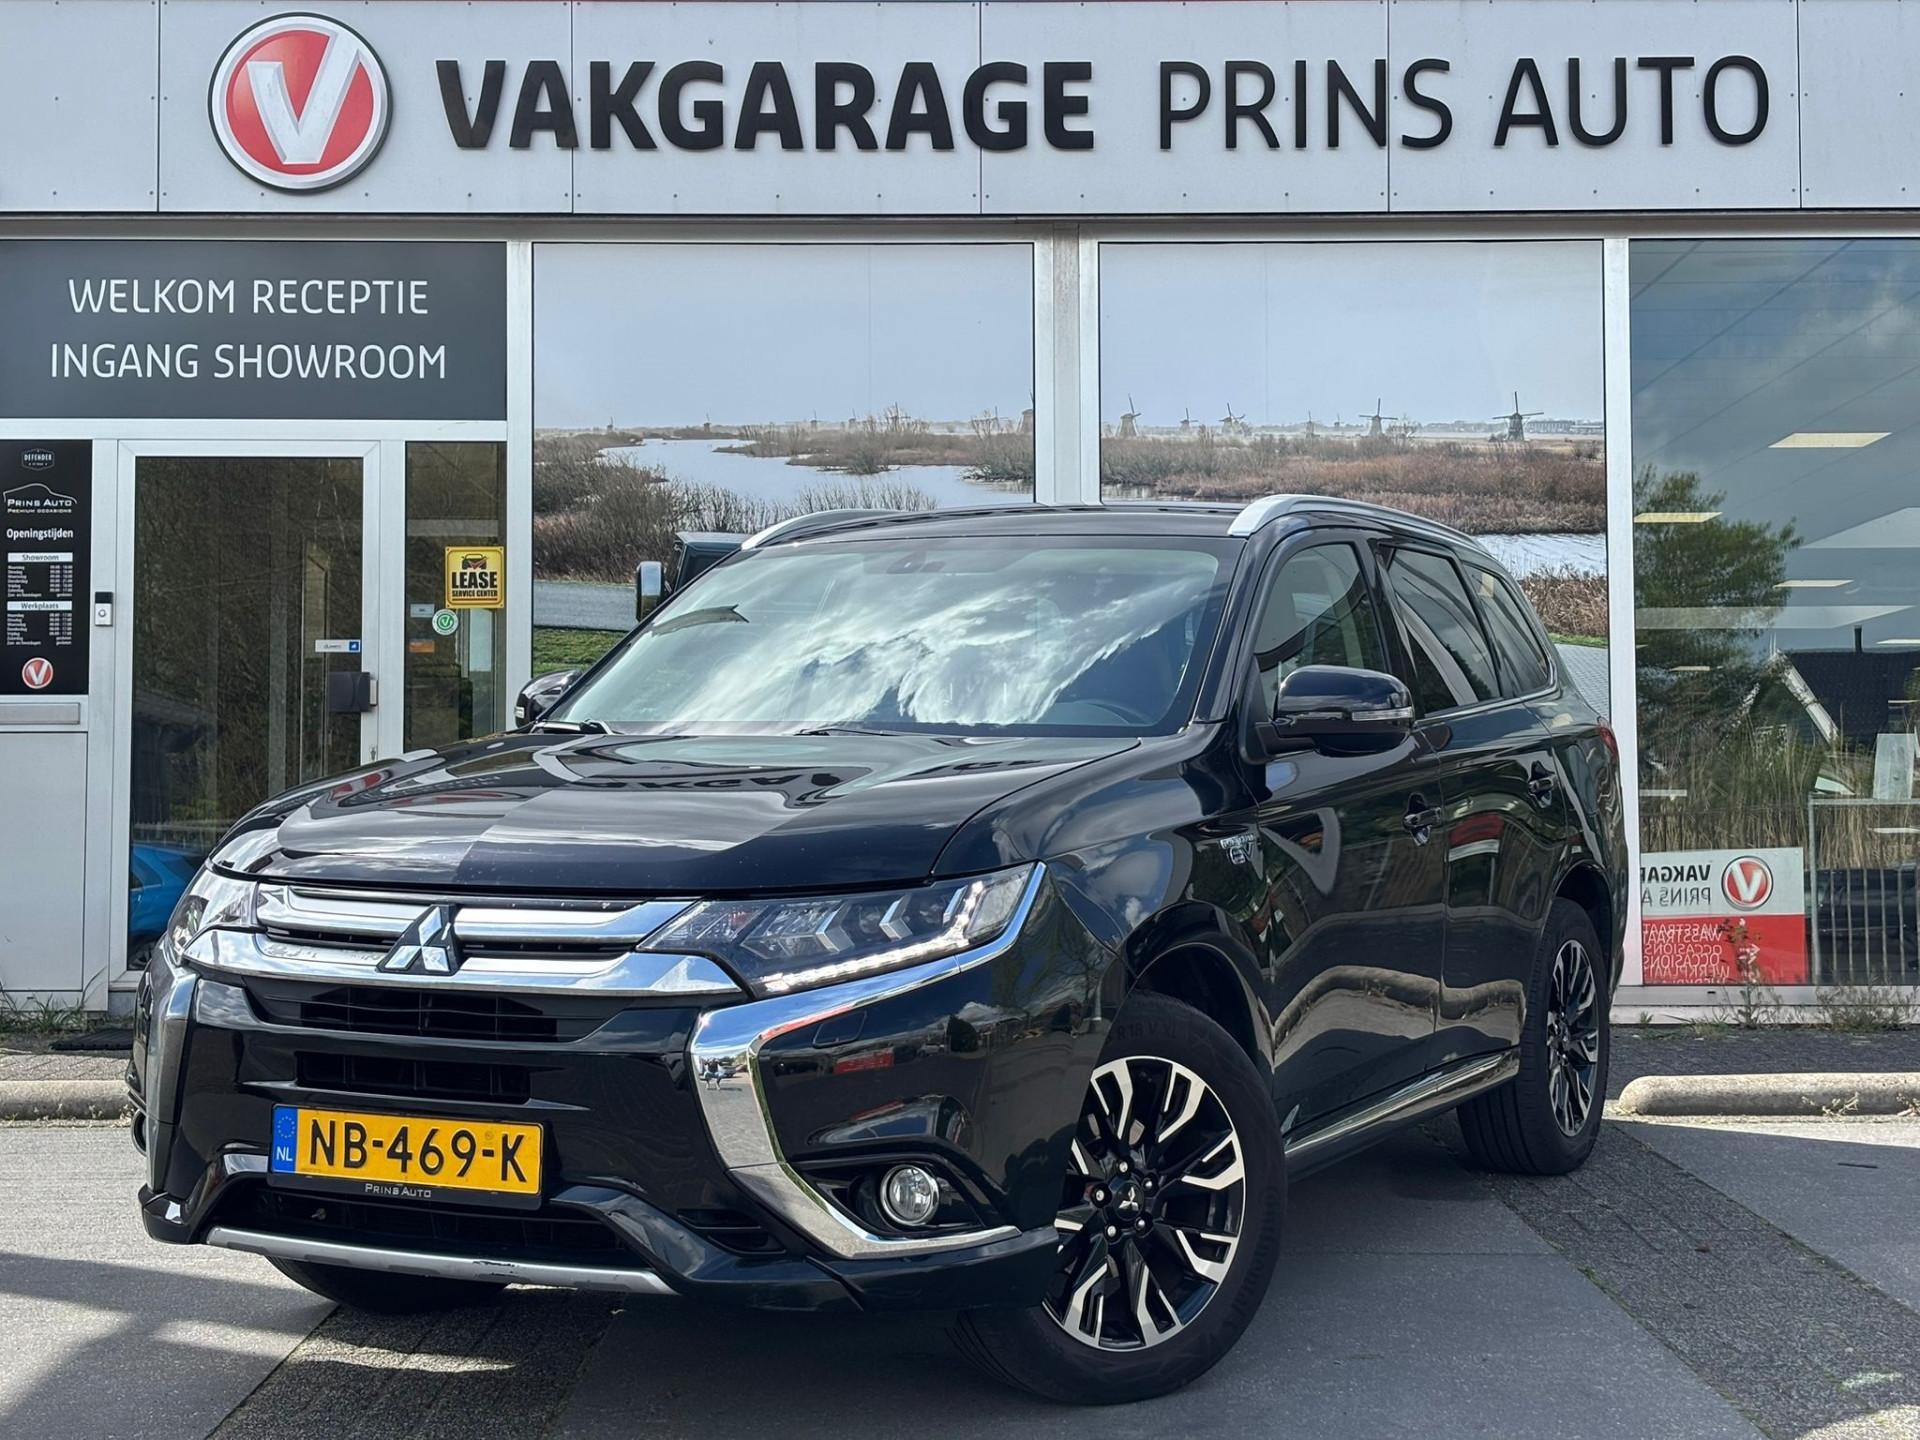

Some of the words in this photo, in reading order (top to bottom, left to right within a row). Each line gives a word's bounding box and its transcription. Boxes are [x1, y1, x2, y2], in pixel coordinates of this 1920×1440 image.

[436, 59, 1094, 151] VAKGARAGE
[1158, 58, 1453, 150] PRINS
[1492, 54, 1770, 147] AUTO
[68, 278, 236, 315] WELKOM
[252, 278, 429, 315] RECEPTIE
[50, 343, 200, 380] INGANG
[213, 343, 448, 380] SHOWROOM
[7, 498, 40, 507] PRINS
[43, 498, 73, 507] AUTO
[6, 527, 74, 541] Openingstijden
[22, 554, 59, 562] Showroom
[451, 571, 498, 589] LEASE
[451, 589, 476, 598] SERVICE
[476, 589, 498, 598] CENTER
[21, 602, 59, 611] Werkplaats
[276, 1145, 294, 1162] NL
[310, 1118, 528, 1184] NB-469-K
[364, 1183, 399, 1195] PRINS
[401, 1186, 432, 1198] AUTO
